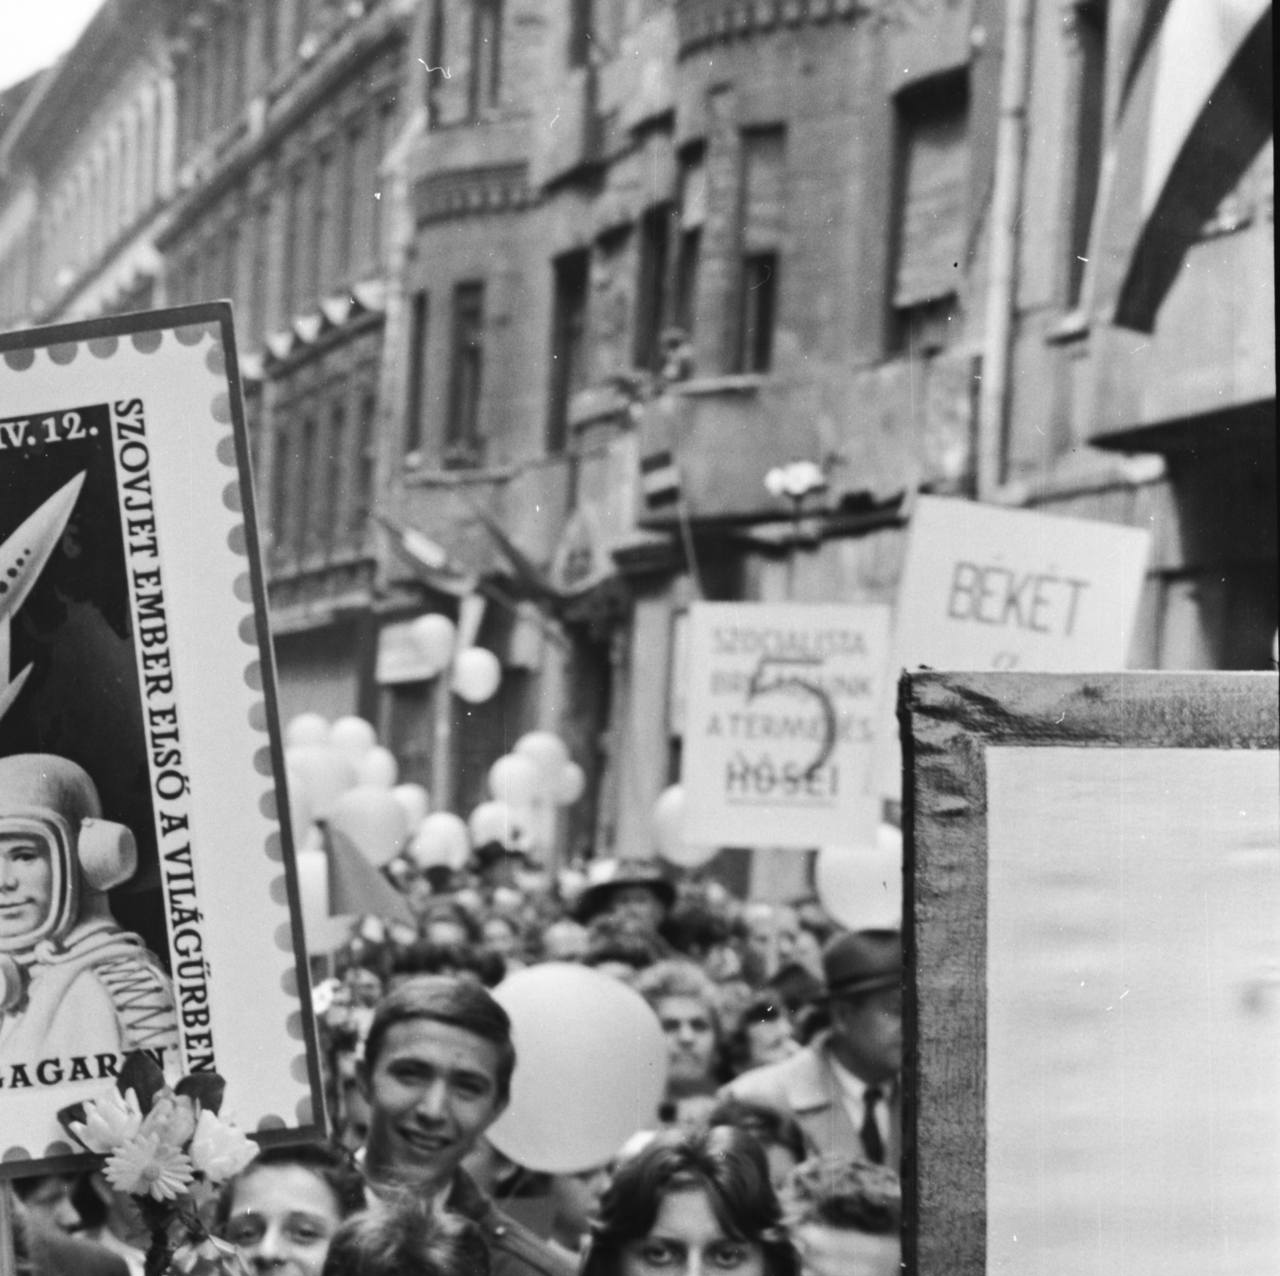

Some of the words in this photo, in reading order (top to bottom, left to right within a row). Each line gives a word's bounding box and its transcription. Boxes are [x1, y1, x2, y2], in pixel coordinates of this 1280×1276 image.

[114, 397, 159, 558] SZOVJET
[133, 565, 173, 700] EMBER
[148, 703, 192, 801] ELSŐ
[159, 809, 190, 838] A
